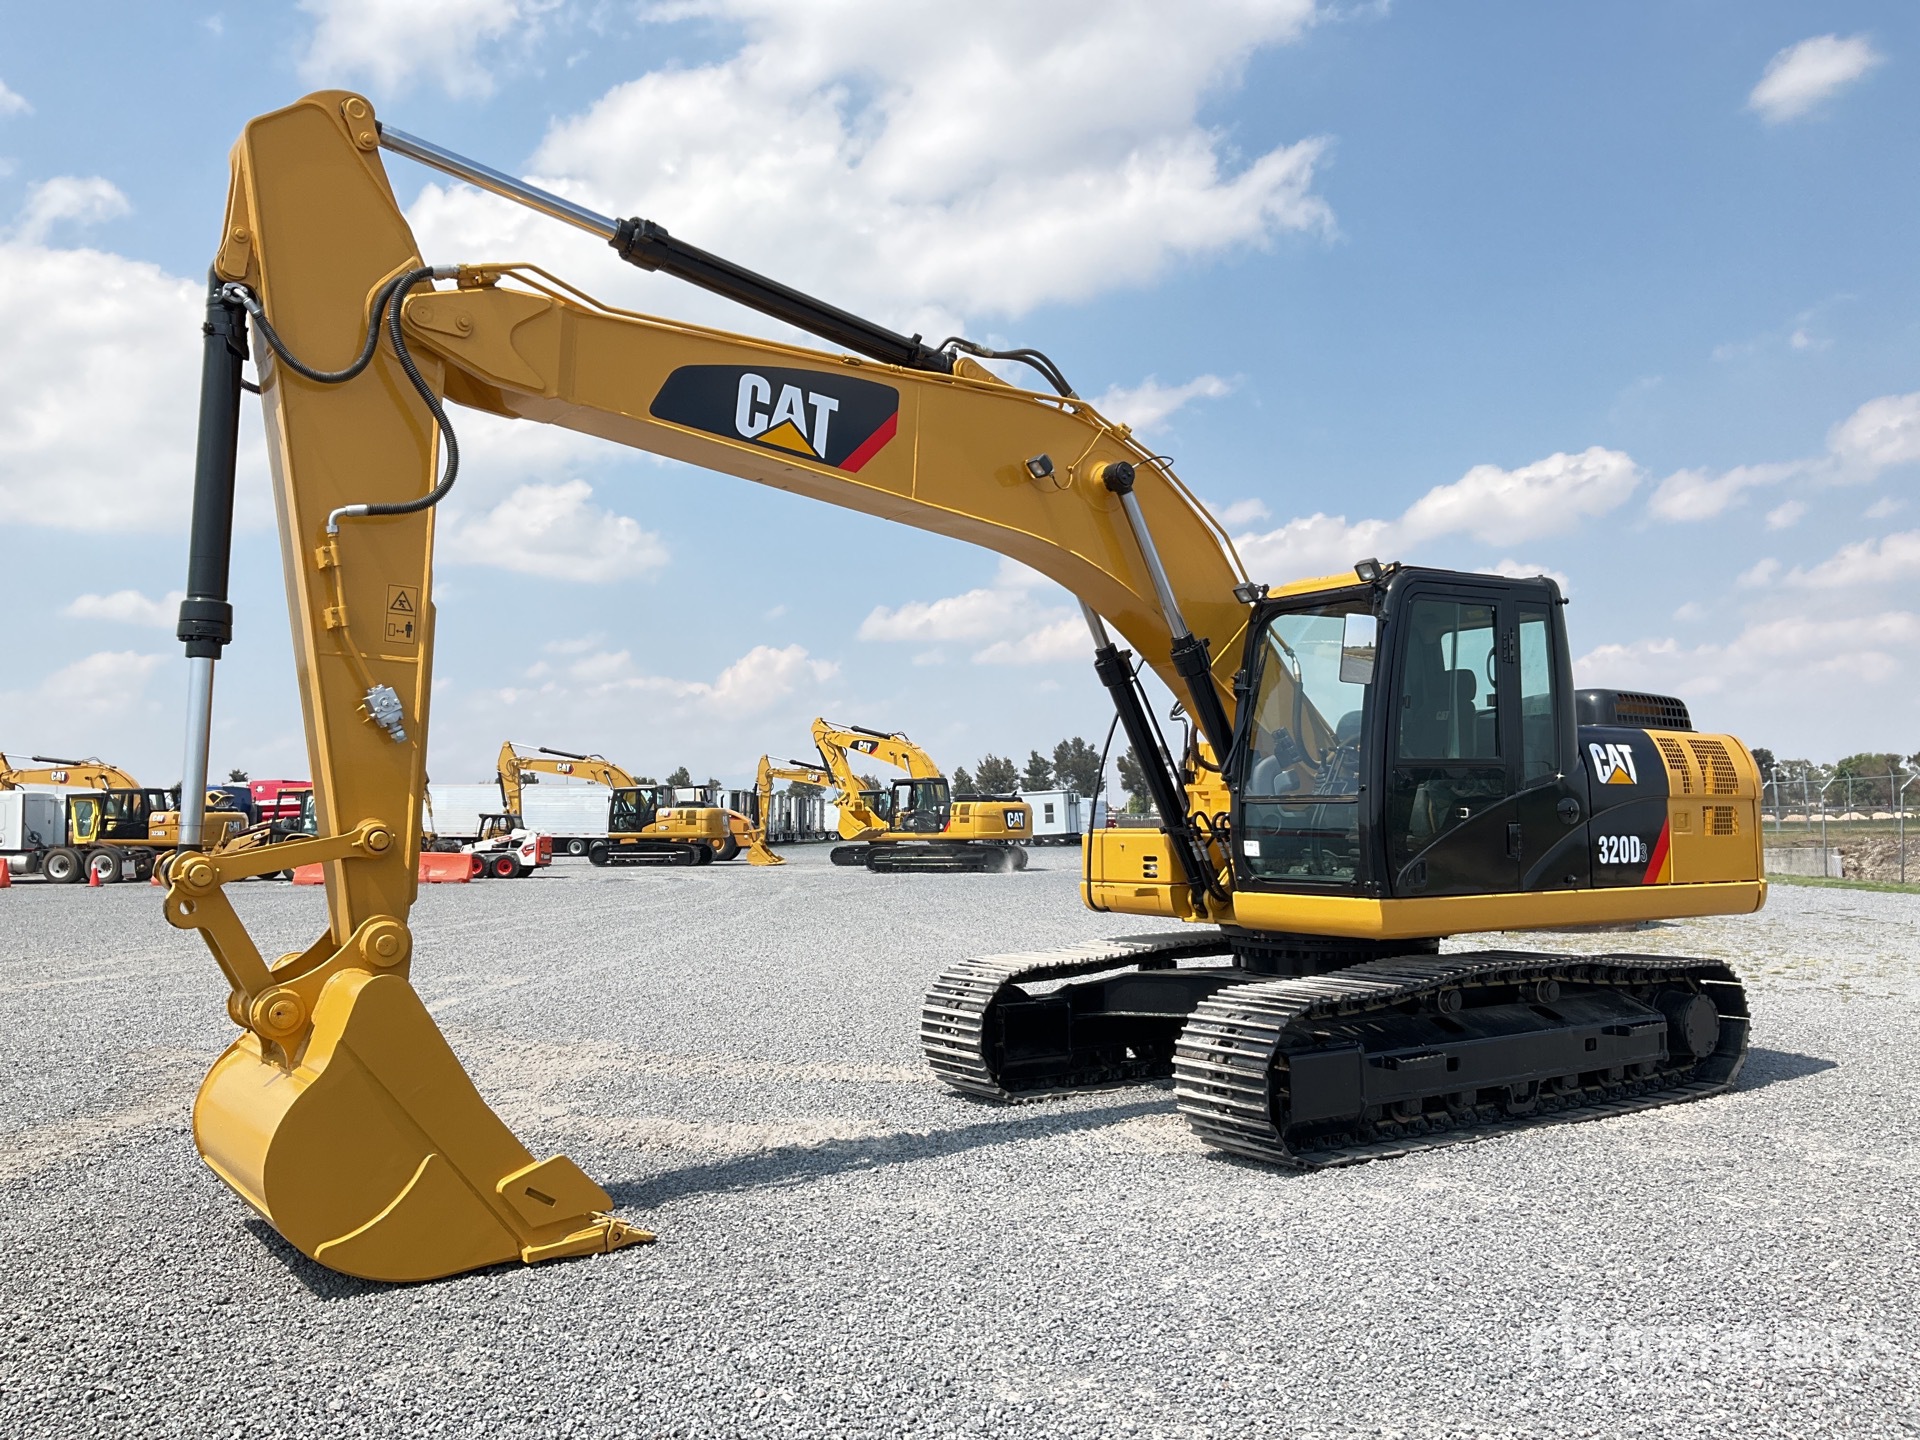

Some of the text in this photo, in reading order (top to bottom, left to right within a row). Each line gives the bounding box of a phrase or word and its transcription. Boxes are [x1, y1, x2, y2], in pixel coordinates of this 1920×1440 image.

[735, 372, 839, 459] CAT
[858, 741, 872, 753] CAT
[557, 762, 570, 773] CAT
[1588, 743, 1638, 785] CAT
[51, 771, 66, 781] CAT
[808, 774, 818, 782] CAT
[1007, 812, 1024, 828] CAT
[228, 821, 240, 832] CAT
[1598, 835, 1648, 864] 320D3
